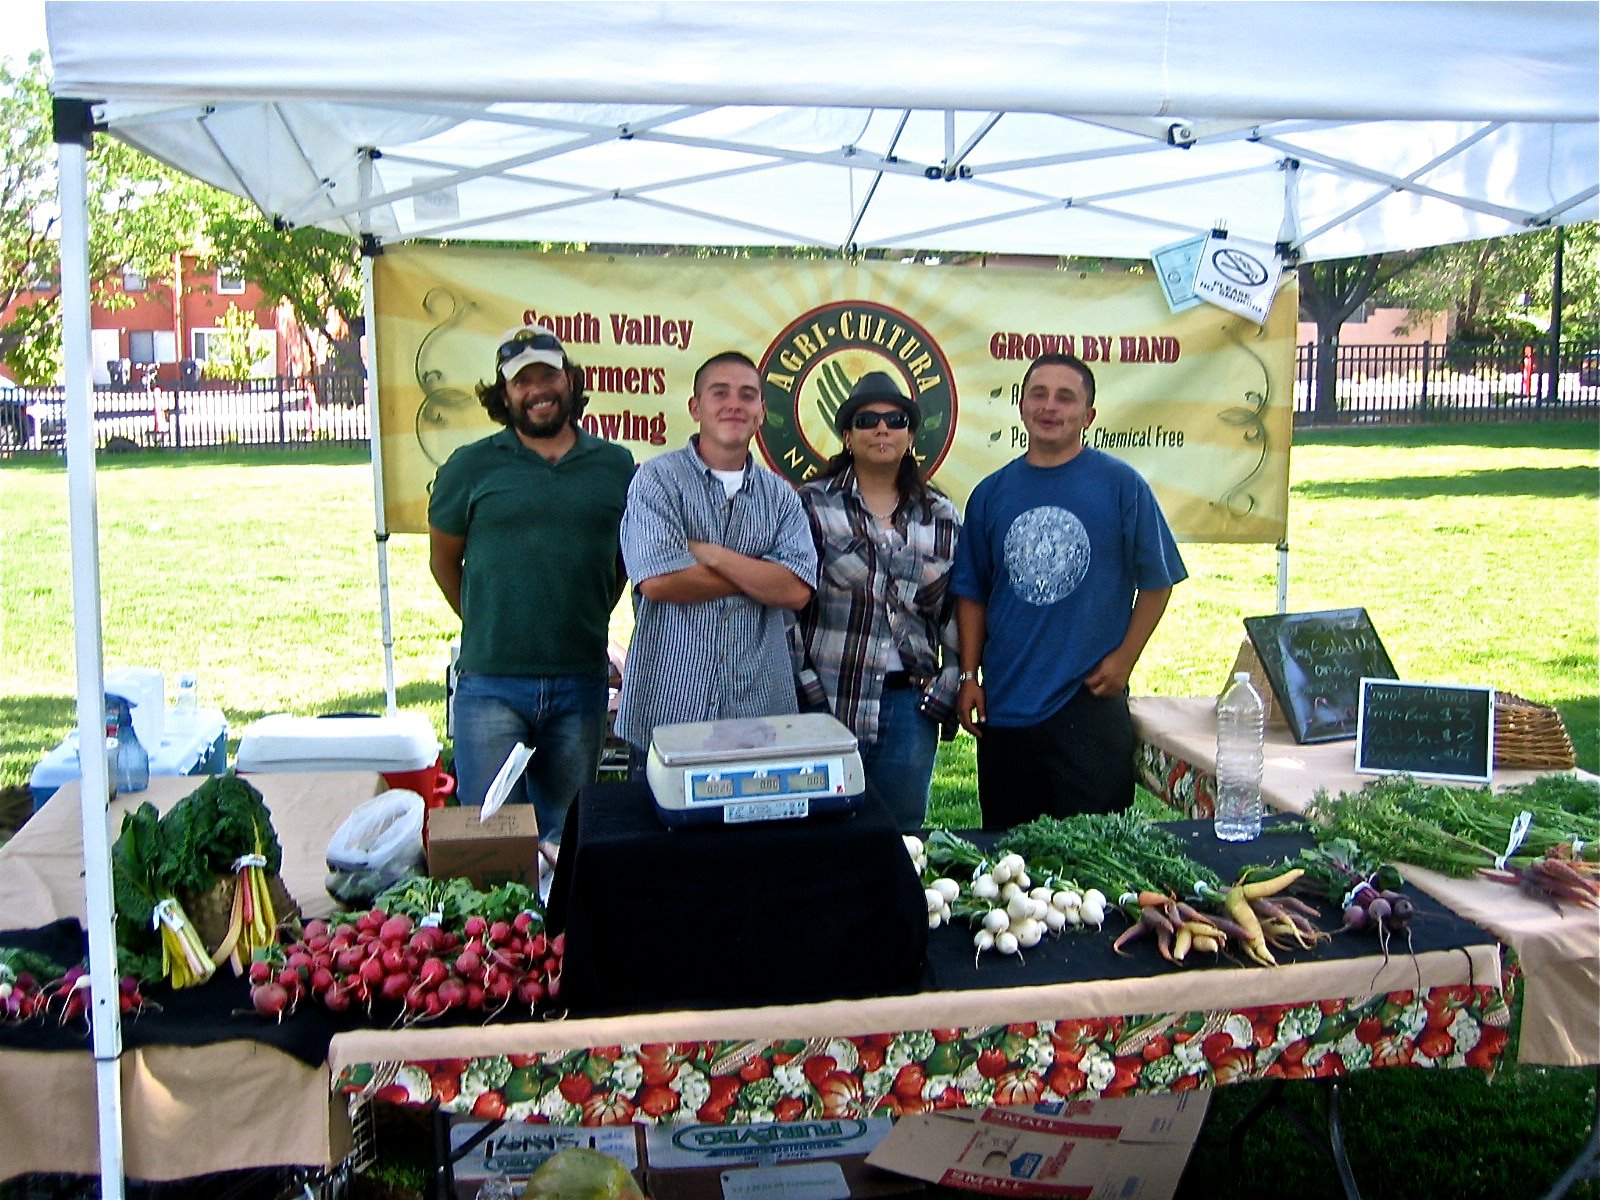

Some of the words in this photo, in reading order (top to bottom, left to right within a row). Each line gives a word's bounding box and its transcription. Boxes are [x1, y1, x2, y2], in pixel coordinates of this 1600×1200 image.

[610, 314, 694, 351] Valley
[989, 331, 1075, 361] GROWN
[1081, 335, 1113, 362] BY
[1119, 336, 1181, 364] HAND
[584, 365, 666, 395] rmers
[580, 410, 667, 446] owing
[1093, 425, 1151, 448] Chemical
[1155, 425, 1185, 448] Free
[951, 1171, 1022, 1191] SMALL
